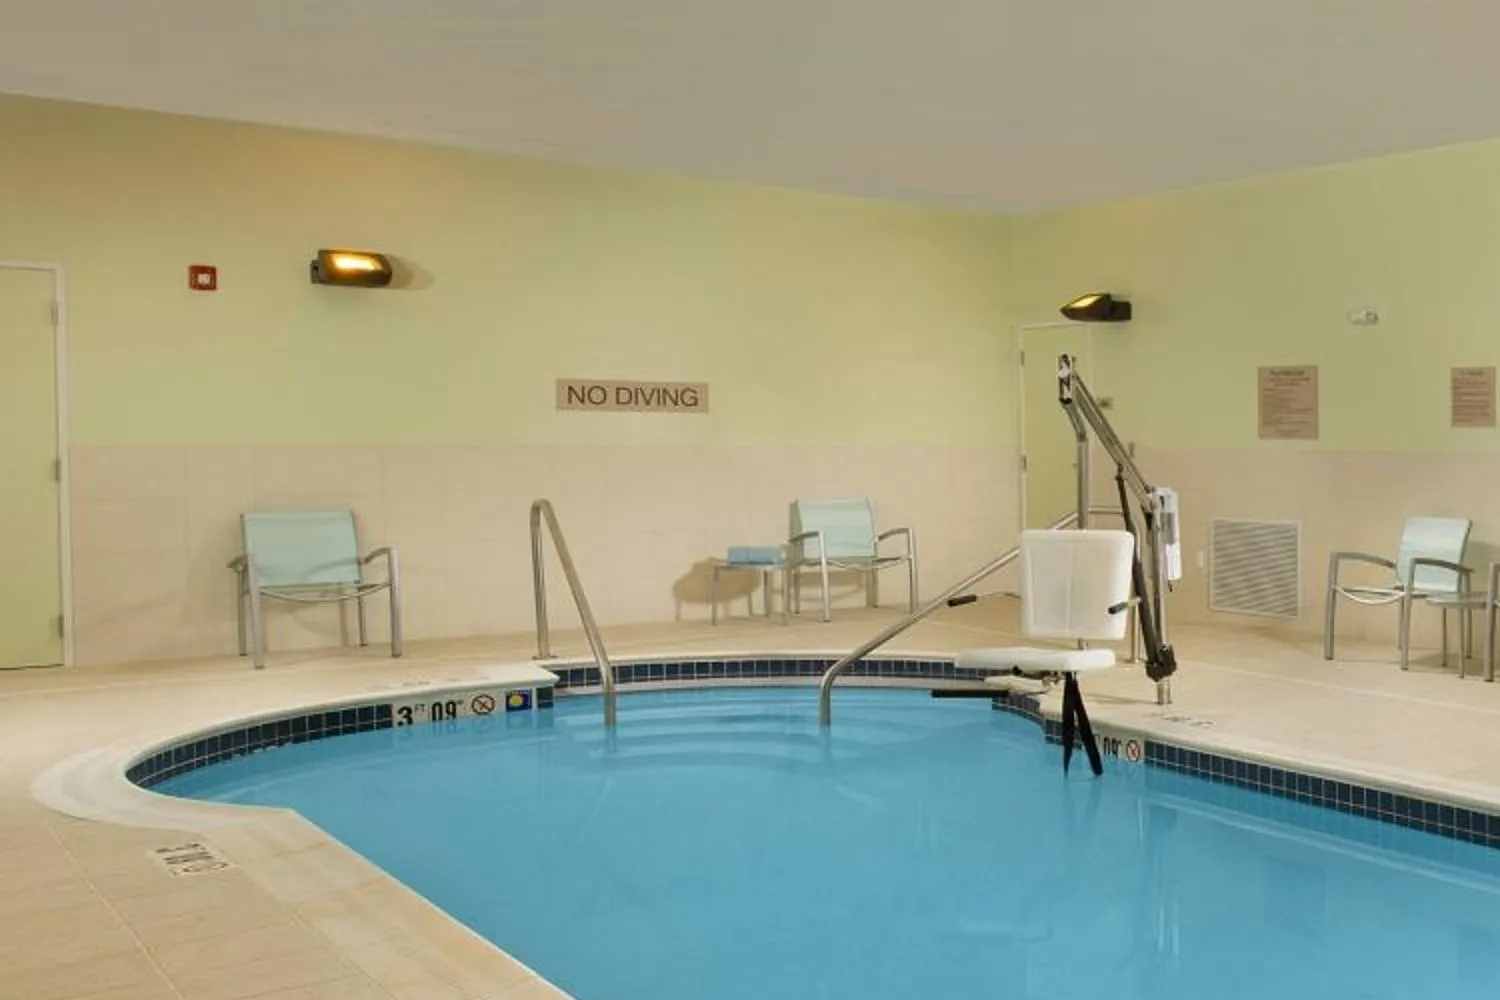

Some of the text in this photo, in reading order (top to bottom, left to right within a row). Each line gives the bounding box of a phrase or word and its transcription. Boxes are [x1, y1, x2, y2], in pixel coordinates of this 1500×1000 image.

[567, 385, 699, 407] NO DIVING
[397, 705, 414, 727] 3
